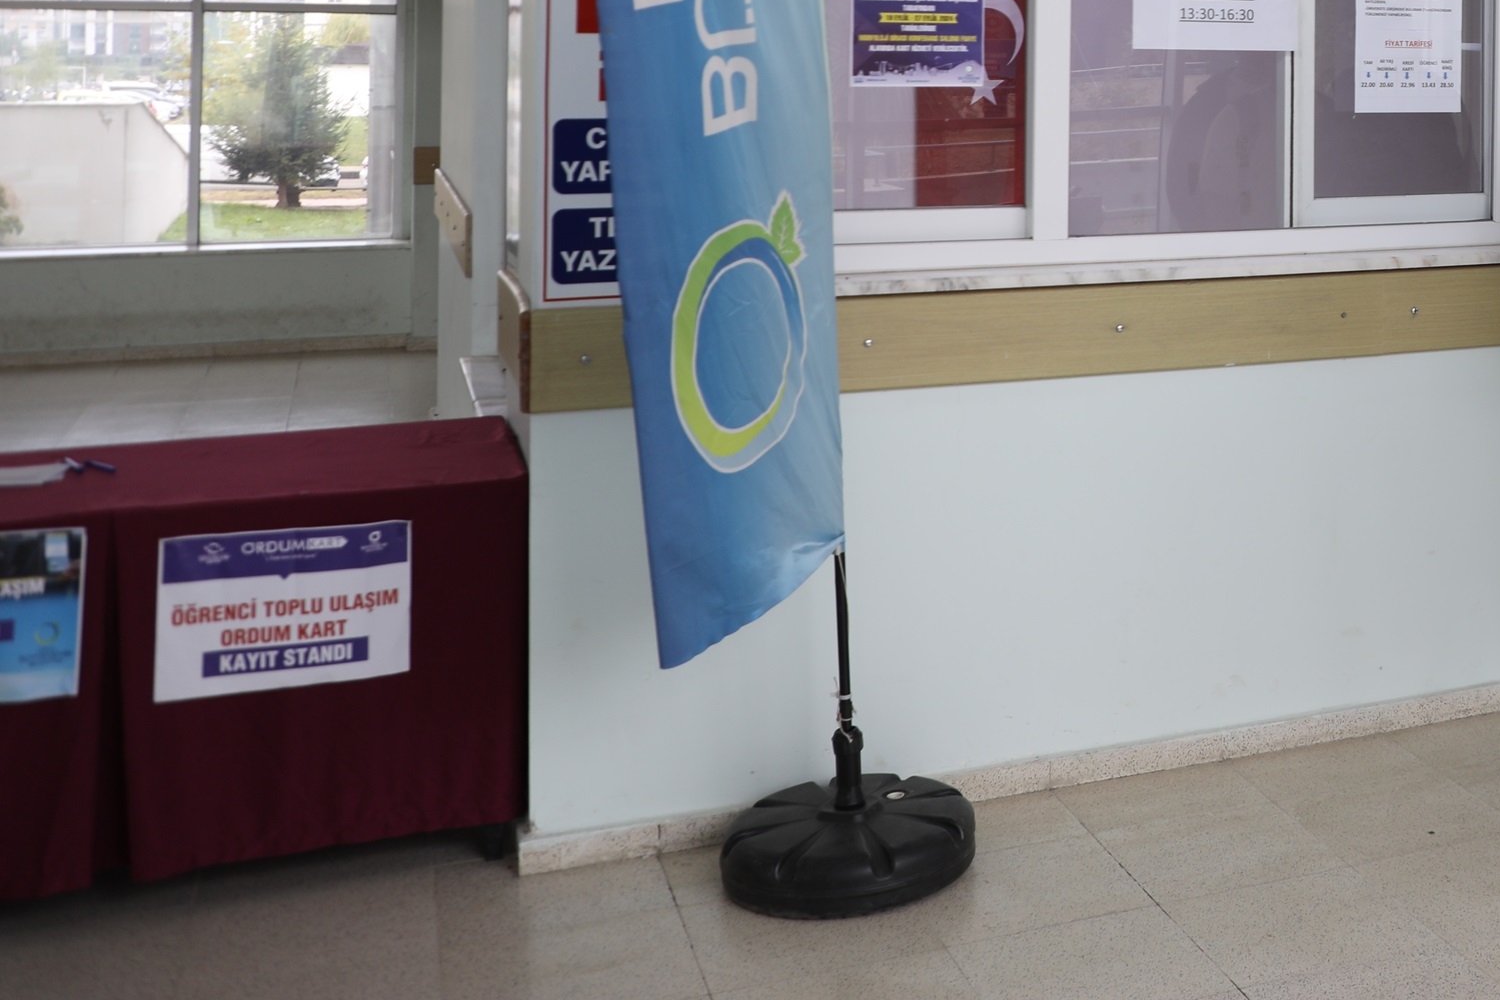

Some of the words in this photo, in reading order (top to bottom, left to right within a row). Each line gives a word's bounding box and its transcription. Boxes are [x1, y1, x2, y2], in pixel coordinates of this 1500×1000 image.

[1179, 7, 1255, 21] 13:30-16:30
[171, 599, 257, 627] ÖĞRENCİ
[264, 598, 324, 618] TOPLU
[329, 588, 399, 614] ULAŞIM
[220, 623, 292, 647] ORDUM
[297, 619, 347, 640] KART
[219, 648, 279, 674] KAYIT
[283, 643, 353, 668] STANDI
